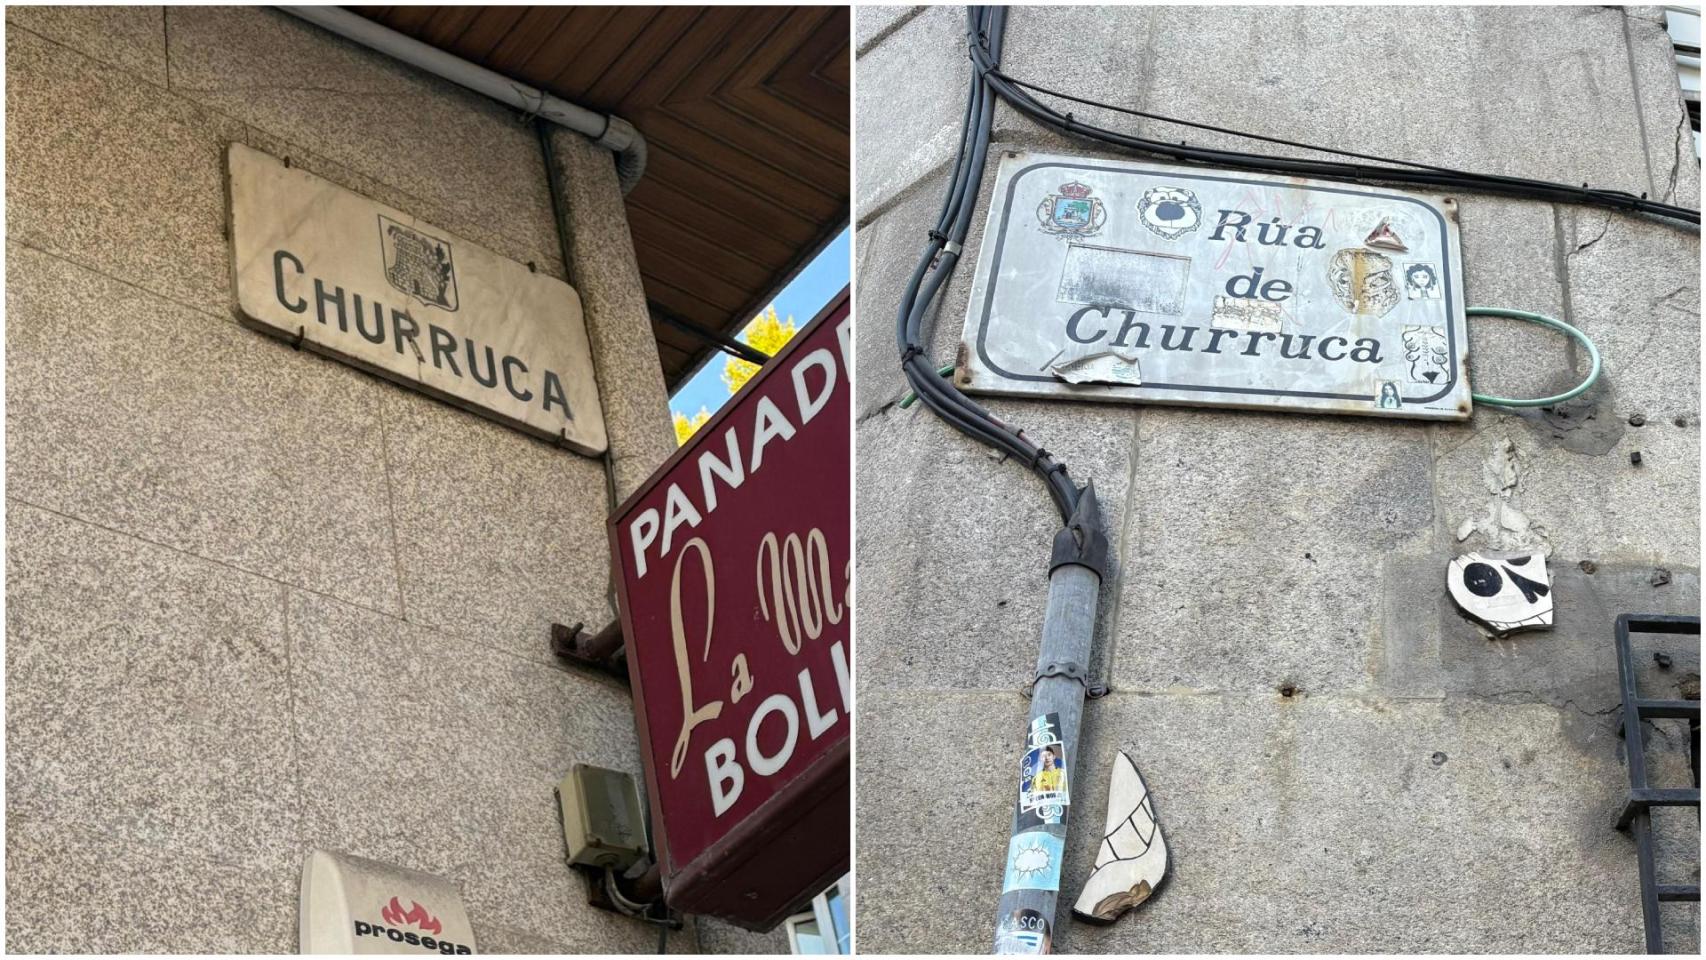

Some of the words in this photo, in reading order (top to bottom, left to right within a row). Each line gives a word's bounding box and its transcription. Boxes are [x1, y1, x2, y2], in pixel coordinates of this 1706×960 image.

[1208, 209, 1326, 250] Rúa
[1226, 266, 1293, 301] de
[273, 250, 574, 420] CHURRUCA
[1066, 307, 1384, 363] Churruca
[671, 537, 754, 780] La
[757, 528, 850, 655] M
